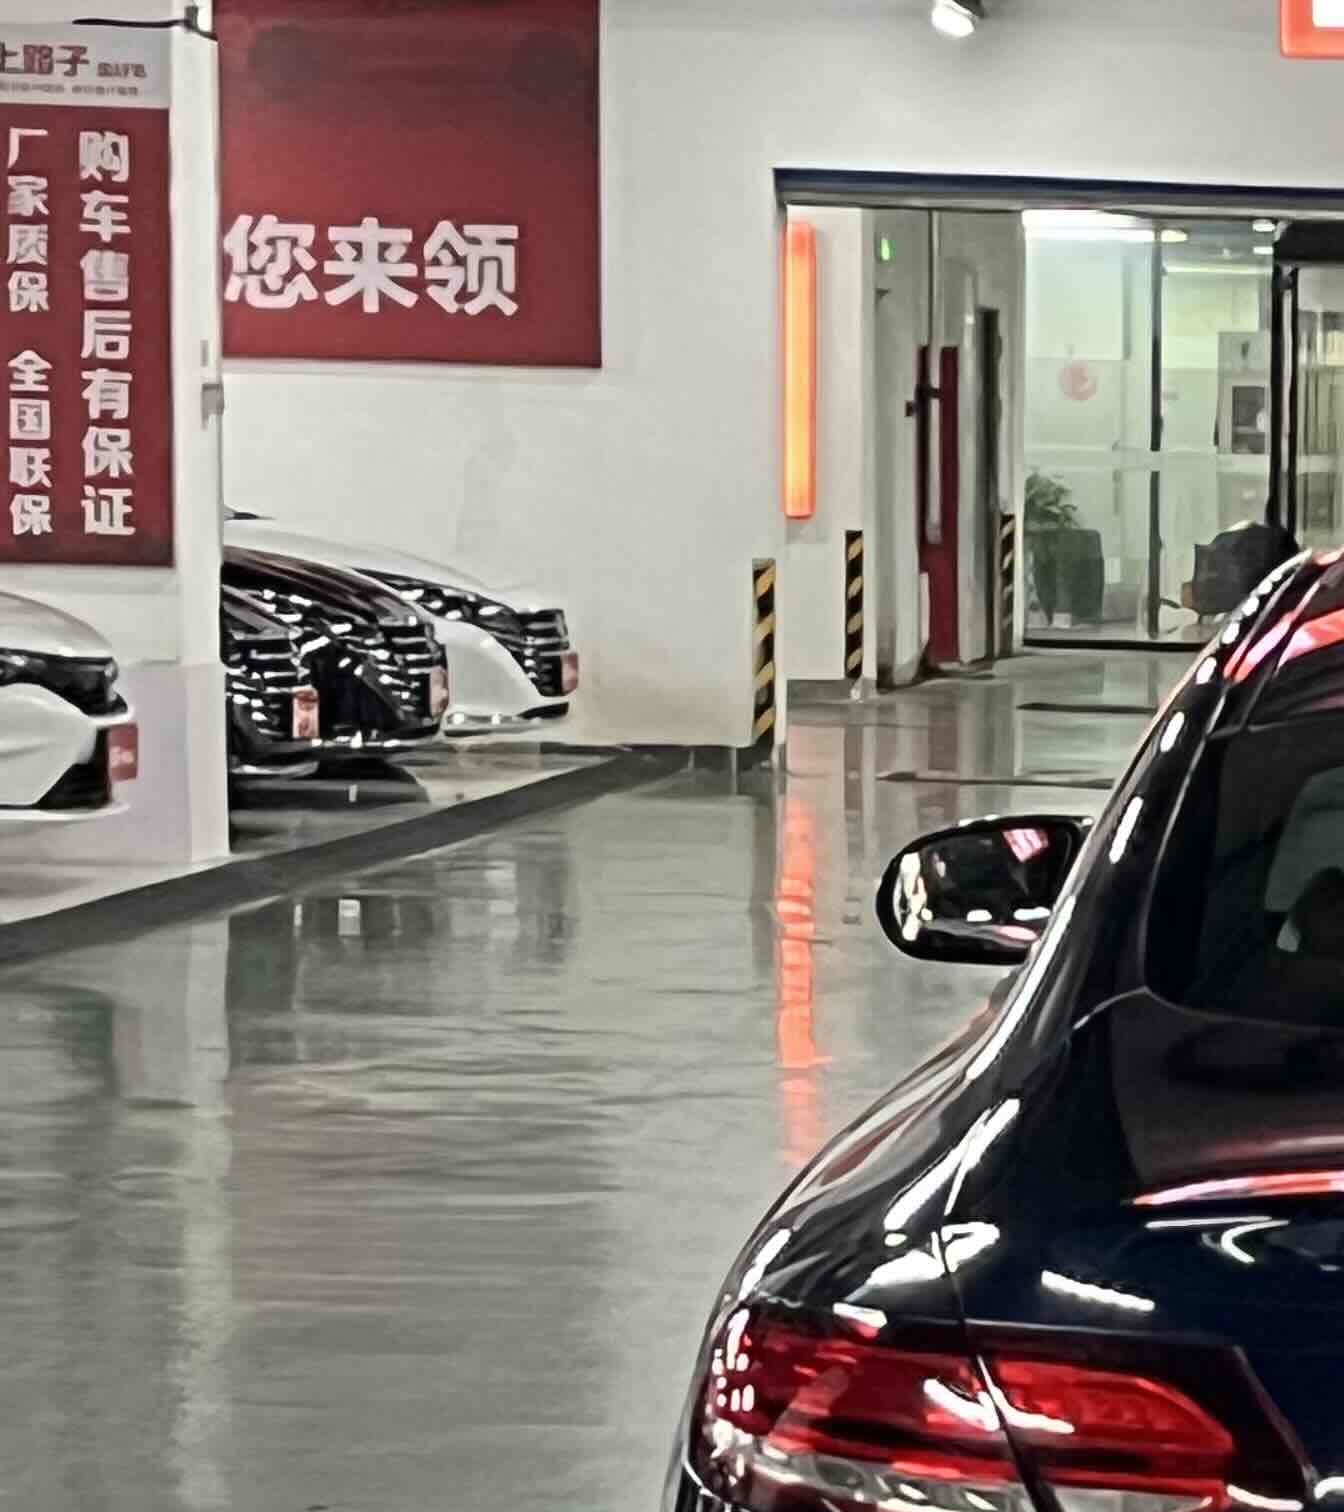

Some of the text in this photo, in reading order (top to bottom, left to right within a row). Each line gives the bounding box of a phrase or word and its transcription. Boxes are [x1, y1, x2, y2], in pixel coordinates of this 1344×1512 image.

[7, 127, 54, 535] 厂家质保 全国联保
[79, 131, 135, 536] 购车售后有保证
[223, 213, 519, 316] 您来领
